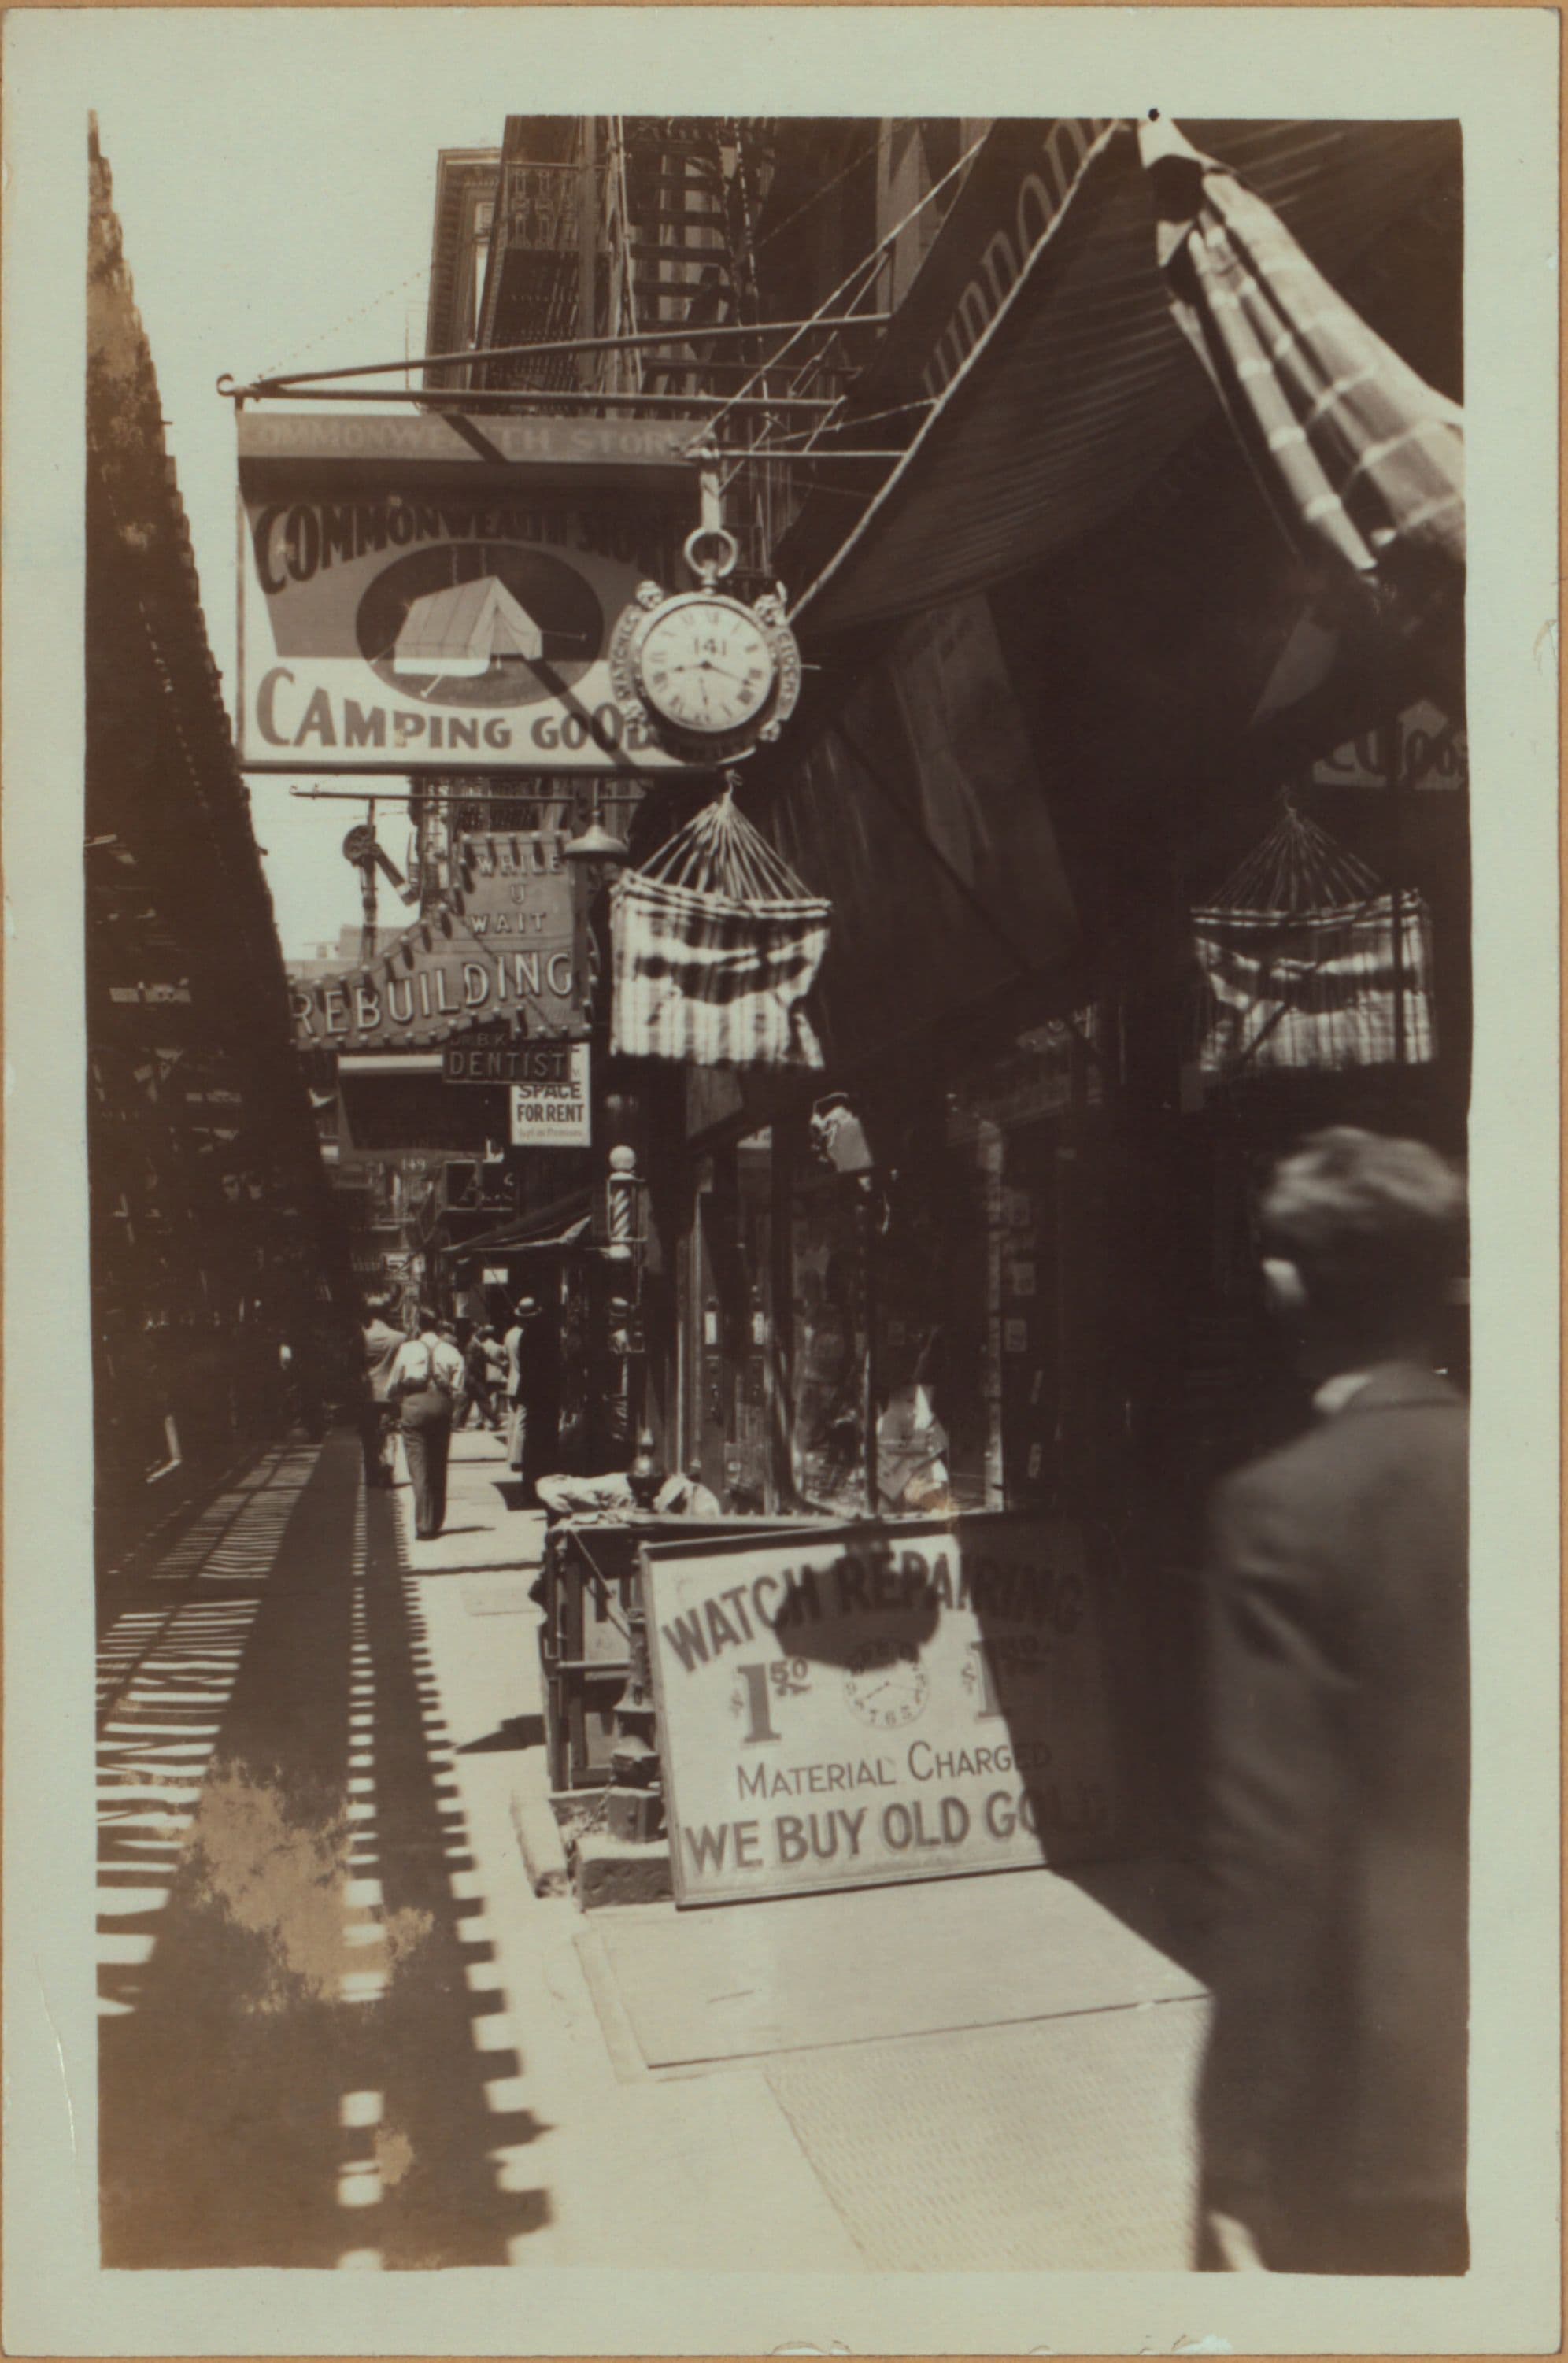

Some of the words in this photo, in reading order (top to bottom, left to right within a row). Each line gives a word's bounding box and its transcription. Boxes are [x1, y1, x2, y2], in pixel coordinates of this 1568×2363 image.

[240, 422, 553, 453] COMMONWEATH
[693, 637, 727, 658] 141
[256, 667, 513, 749] CAMPING
[474, 853, 566, 878] WHILE
[510, 883, 527, 904] U
[471, 912, 548, 935] WAIT
[290, 951, 573, 1037] REBUILDING
[449, 1050, 565, 1078] DENTIST
[518, 1082, 581, 1100] SPACE
[516, 1104, 544, 1123] FOR
[546, 1104, 585, 1123] RENT
[661, 1566, 823, 1674] WATCH
[737, 1758, 897, 1802] MATERIAL
[908, 1739, 1052, 1783] CHARGED
[685, 1819, 764, 1878] WE
[775, 1805, 869, 1867] BUY
[882, 1795, 971, 1851] OLD
